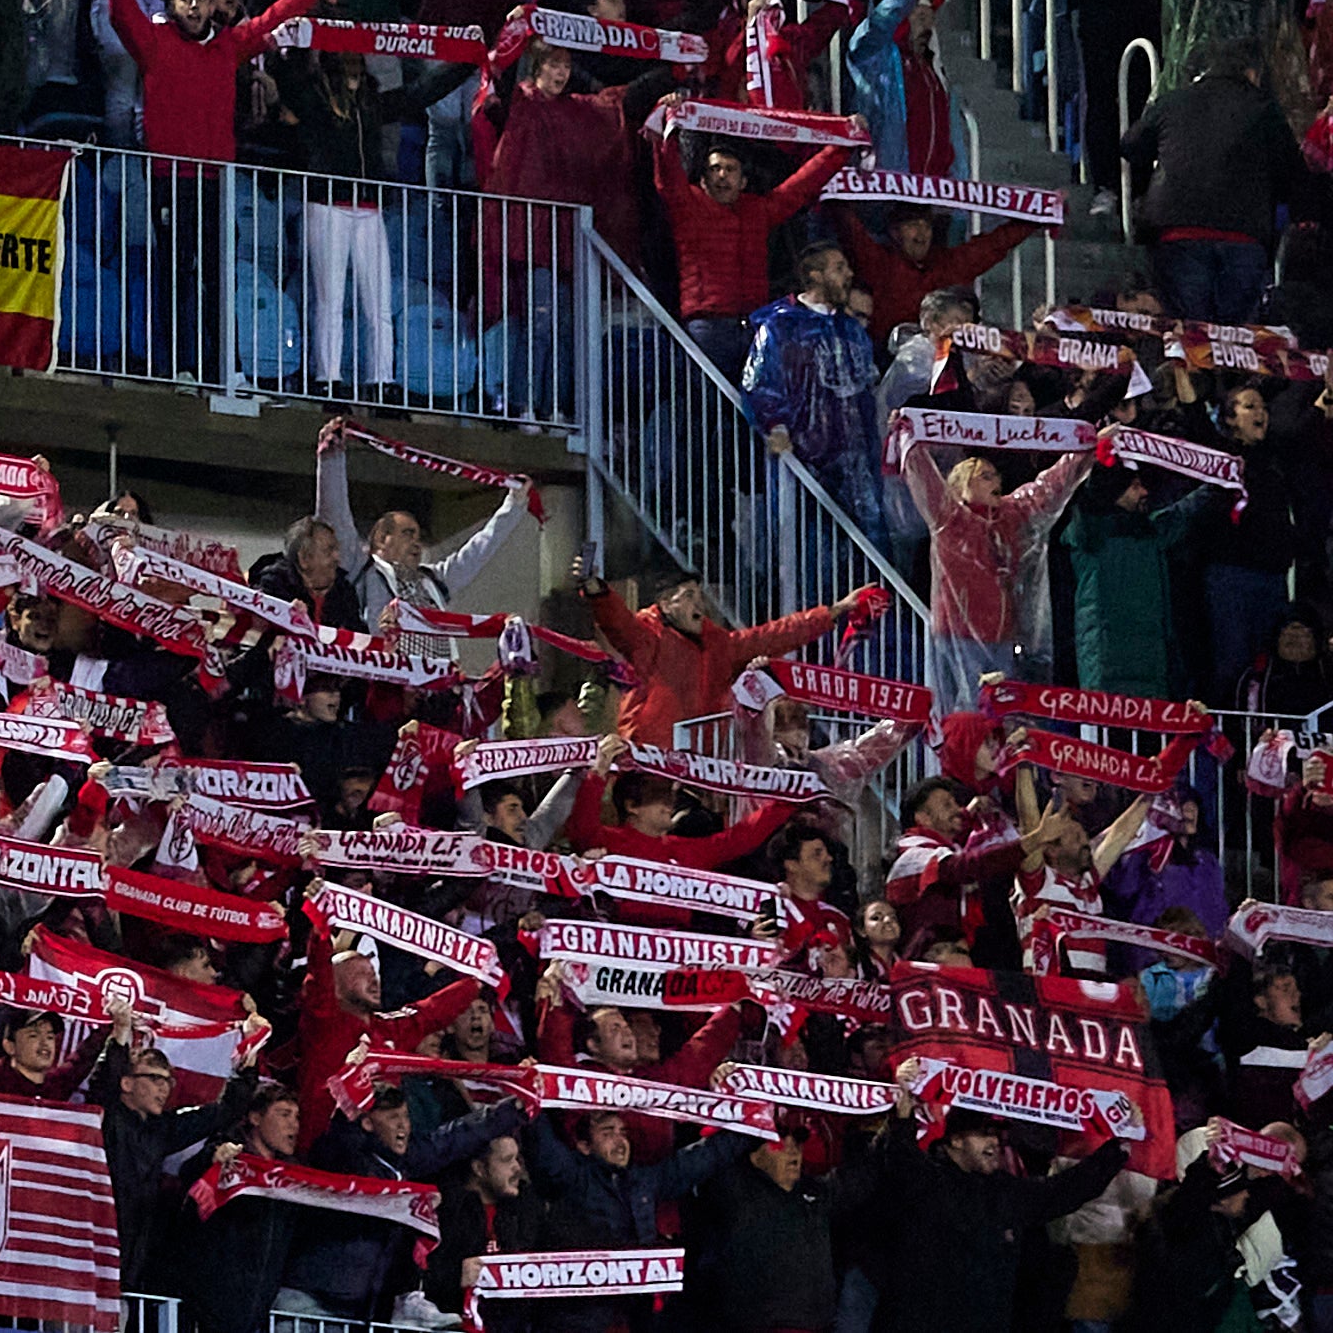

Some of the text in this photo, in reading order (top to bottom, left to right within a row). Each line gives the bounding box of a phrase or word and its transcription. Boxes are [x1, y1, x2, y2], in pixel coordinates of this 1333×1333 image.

[531, 11, 640, 49] GRANADA
[1058, 337, 1119, 368] GRANA
[1211, 345, 1259, 370] EURO
[921, 411, 1064, 445] Eterna Lucha
[790, 665, 915, 712] GRADA 1931
[1037, 689, 1153, 722] GRANADA
[1048, 738, 1132, 780] GRANADA
[338, 829, 431, 857] GRANADA
[596, 863, 632, 890] LA
[113, 881, 251, 927] GRANADA CLUB DE FÚTBOL
[595, 966, 698, 998] GRANADA
[899, 987, 1145, 1067] GRANADA
[557, 1075, 745, 1124] LA HORIZONTAL
[942, 1068, 1095, 1119] VOLVEREMOS
[496, 1259, 683, 1289] HORIZONTAL
